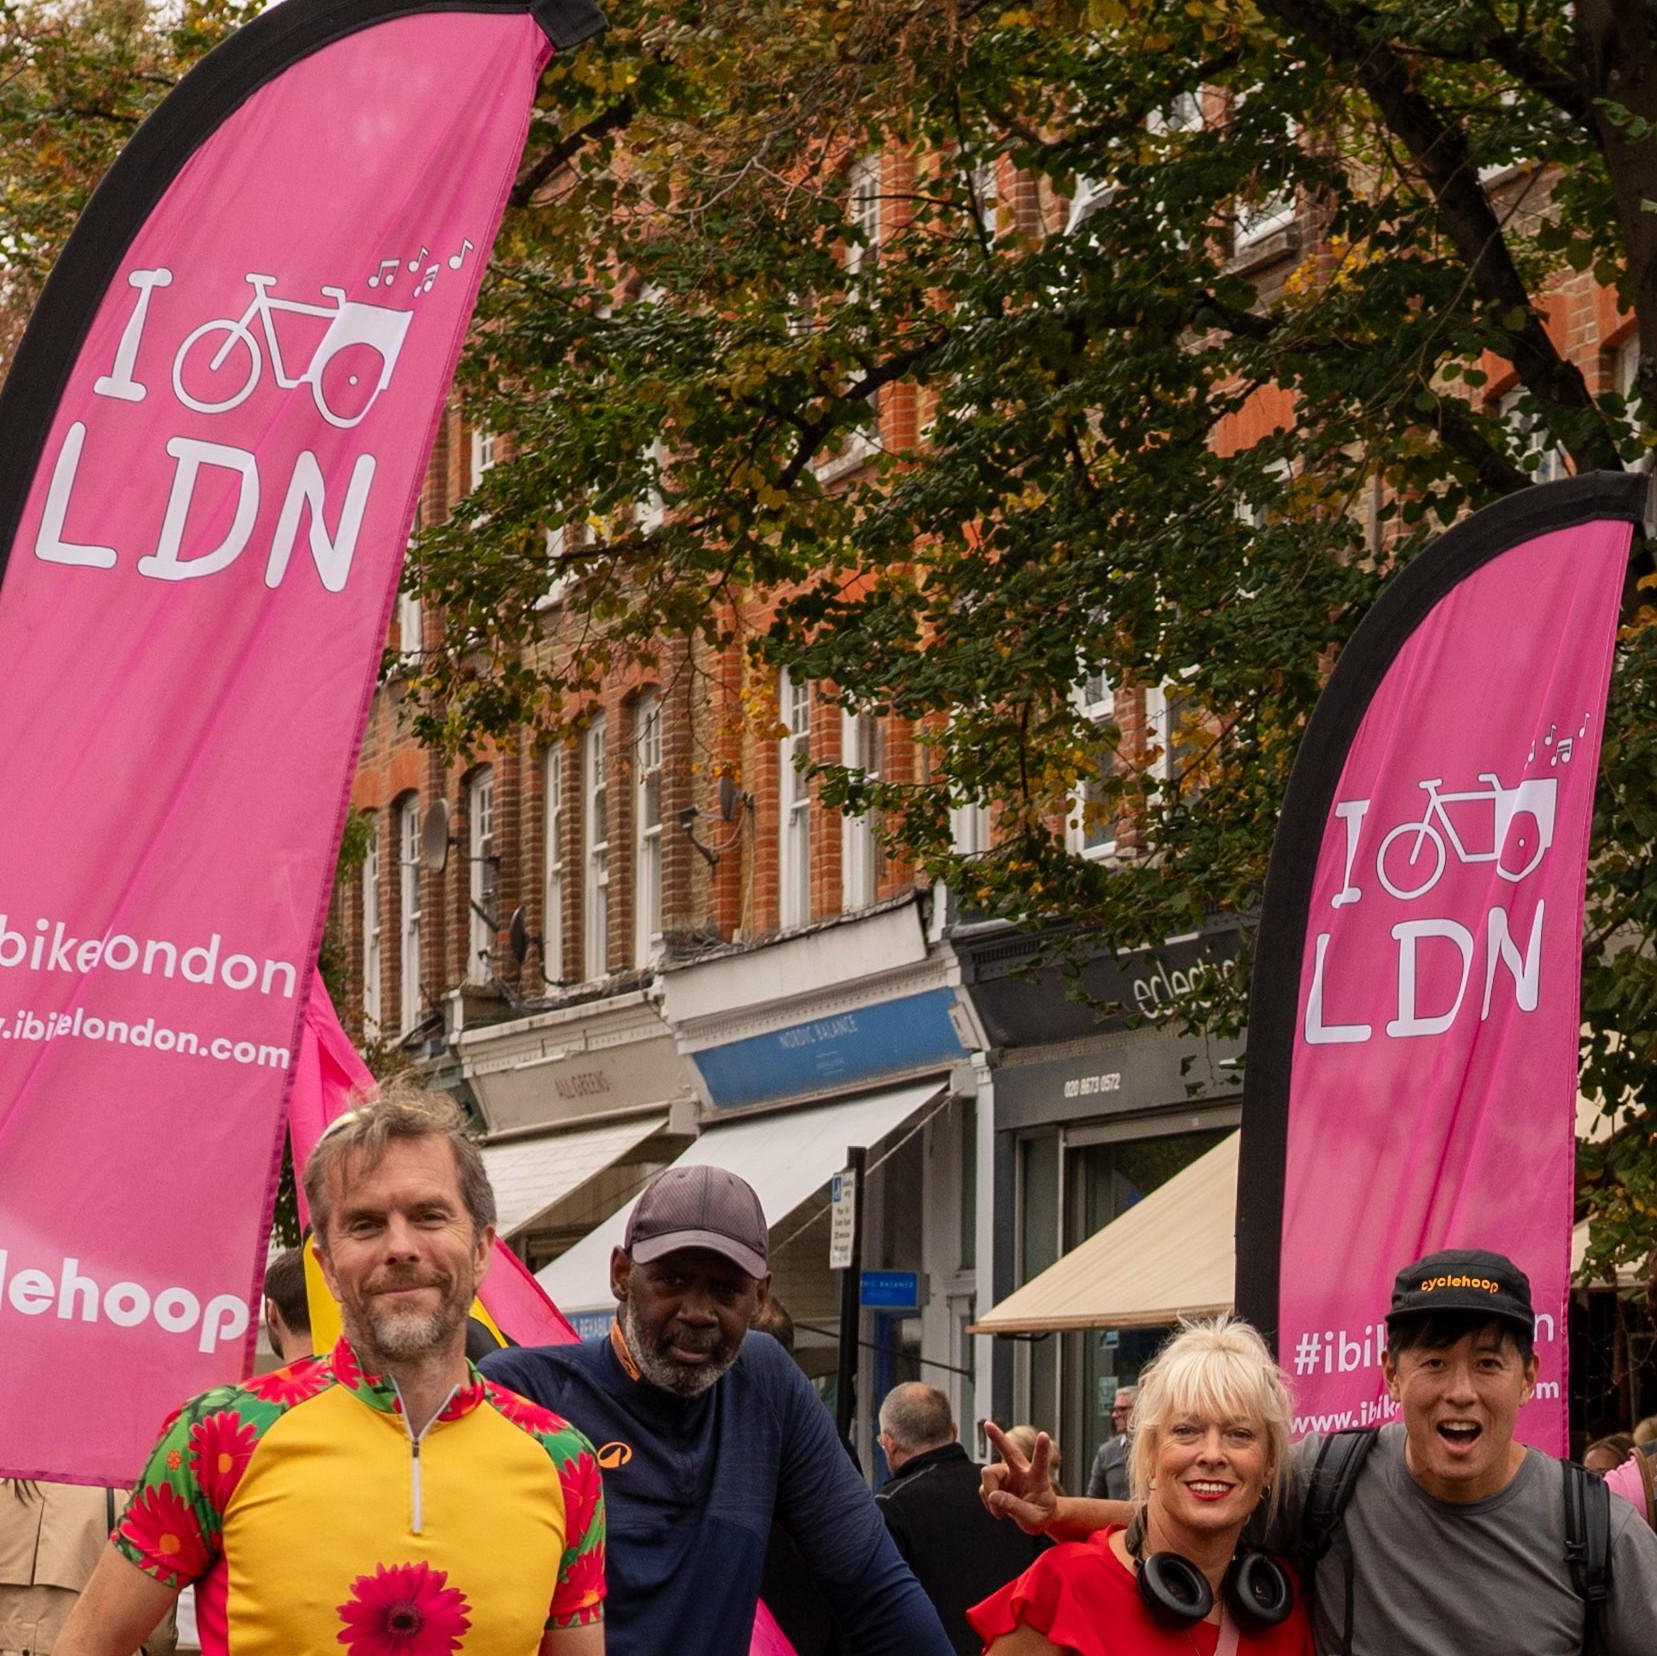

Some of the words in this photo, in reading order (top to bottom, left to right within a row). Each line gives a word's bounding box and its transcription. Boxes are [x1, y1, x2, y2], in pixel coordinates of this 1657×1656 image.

[93, 267, 173, 402] I
[34, 420, 377, 593] LDN
[1331, 799, 1371, 909] I
[1304, 898, 1545, 1045] LDN
[1064, 1079, 1080, 1098] 020
[1080, 1075, 1100, 1096] 8673
[1420, 1274, 1500, 1294] cyclehoop
